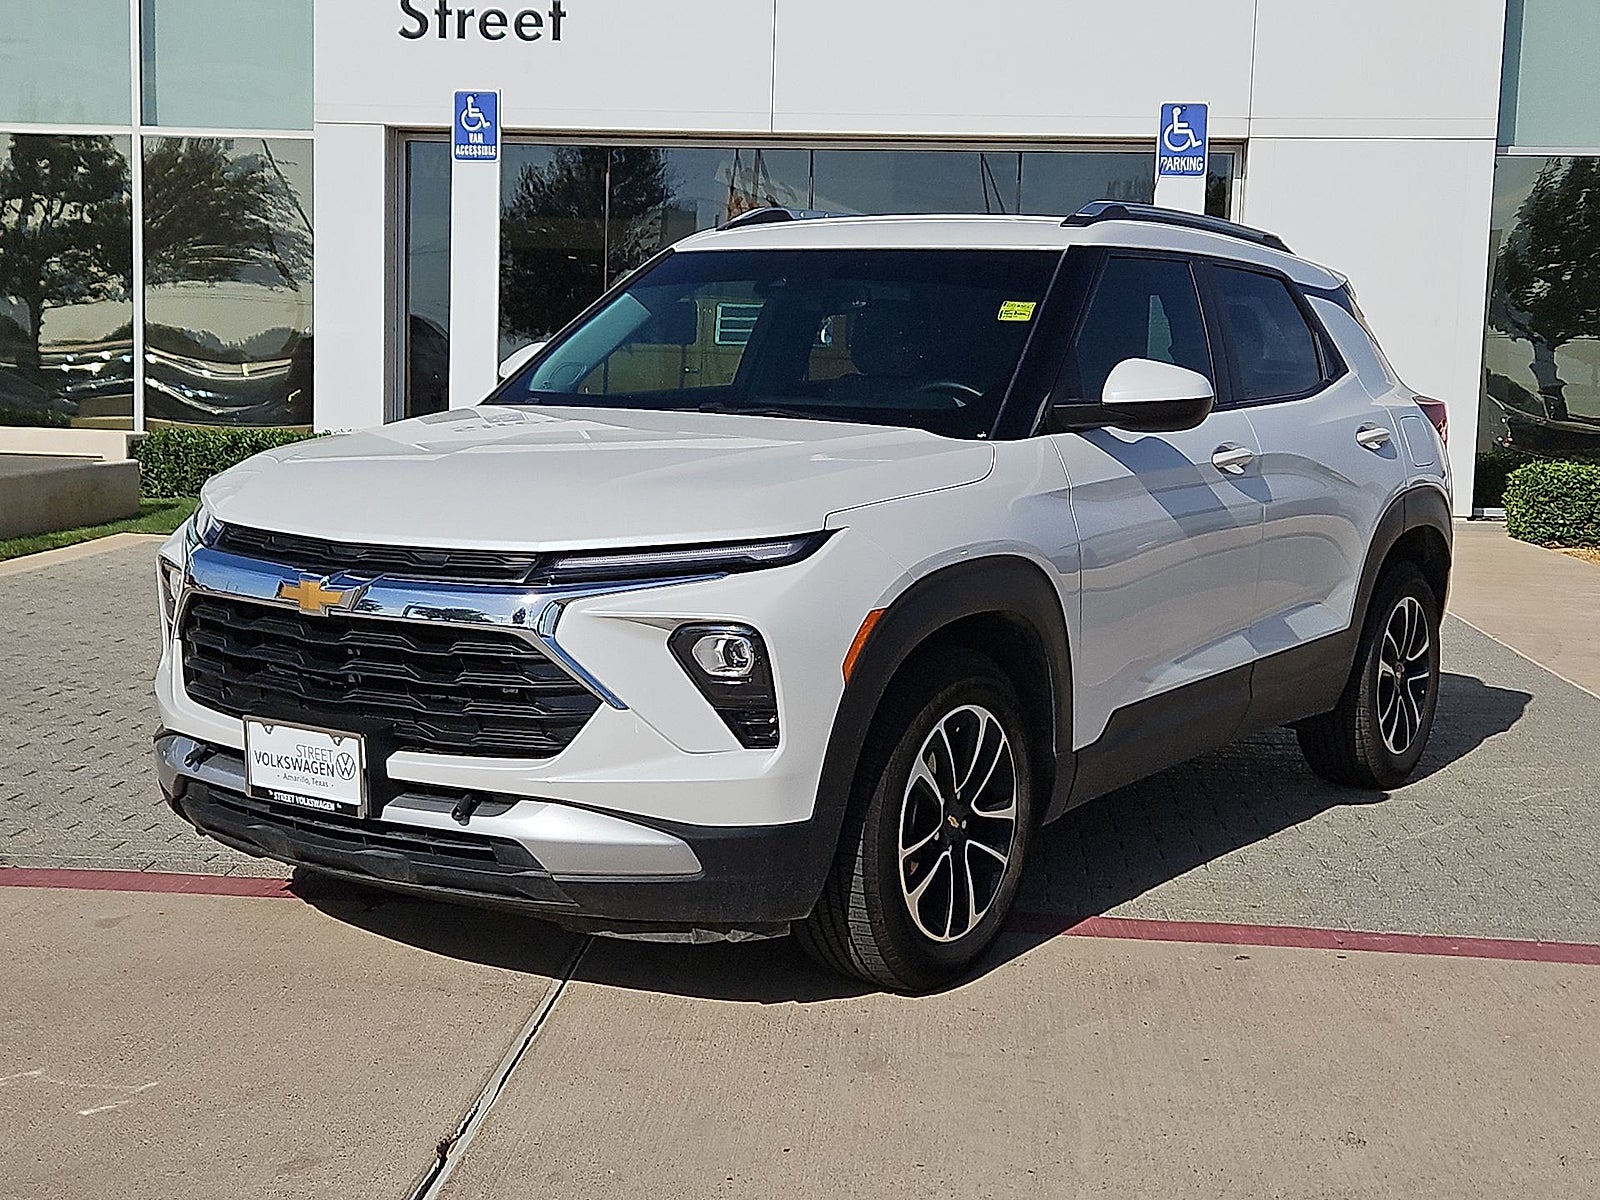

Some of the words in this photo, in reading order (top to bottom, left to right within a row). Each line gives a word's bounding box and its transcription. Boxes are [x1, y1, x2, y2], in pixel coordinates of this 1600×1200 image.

[397, 0, 567, 41] Street
[468, 132, 484, 143] VAN
[455, 144, 497, 157] ACCESSIBLE
[1160, 156, 1204, 171] PARKING
[296, 744, 334, 762] STREET
[254, 750, 335, 777] VOLKSWAGEN
[312, 777, 329, 788] Texas
[274, 792, 295, 803] STREET
[295, 795, 335, 811] VOLKSWAGEN
